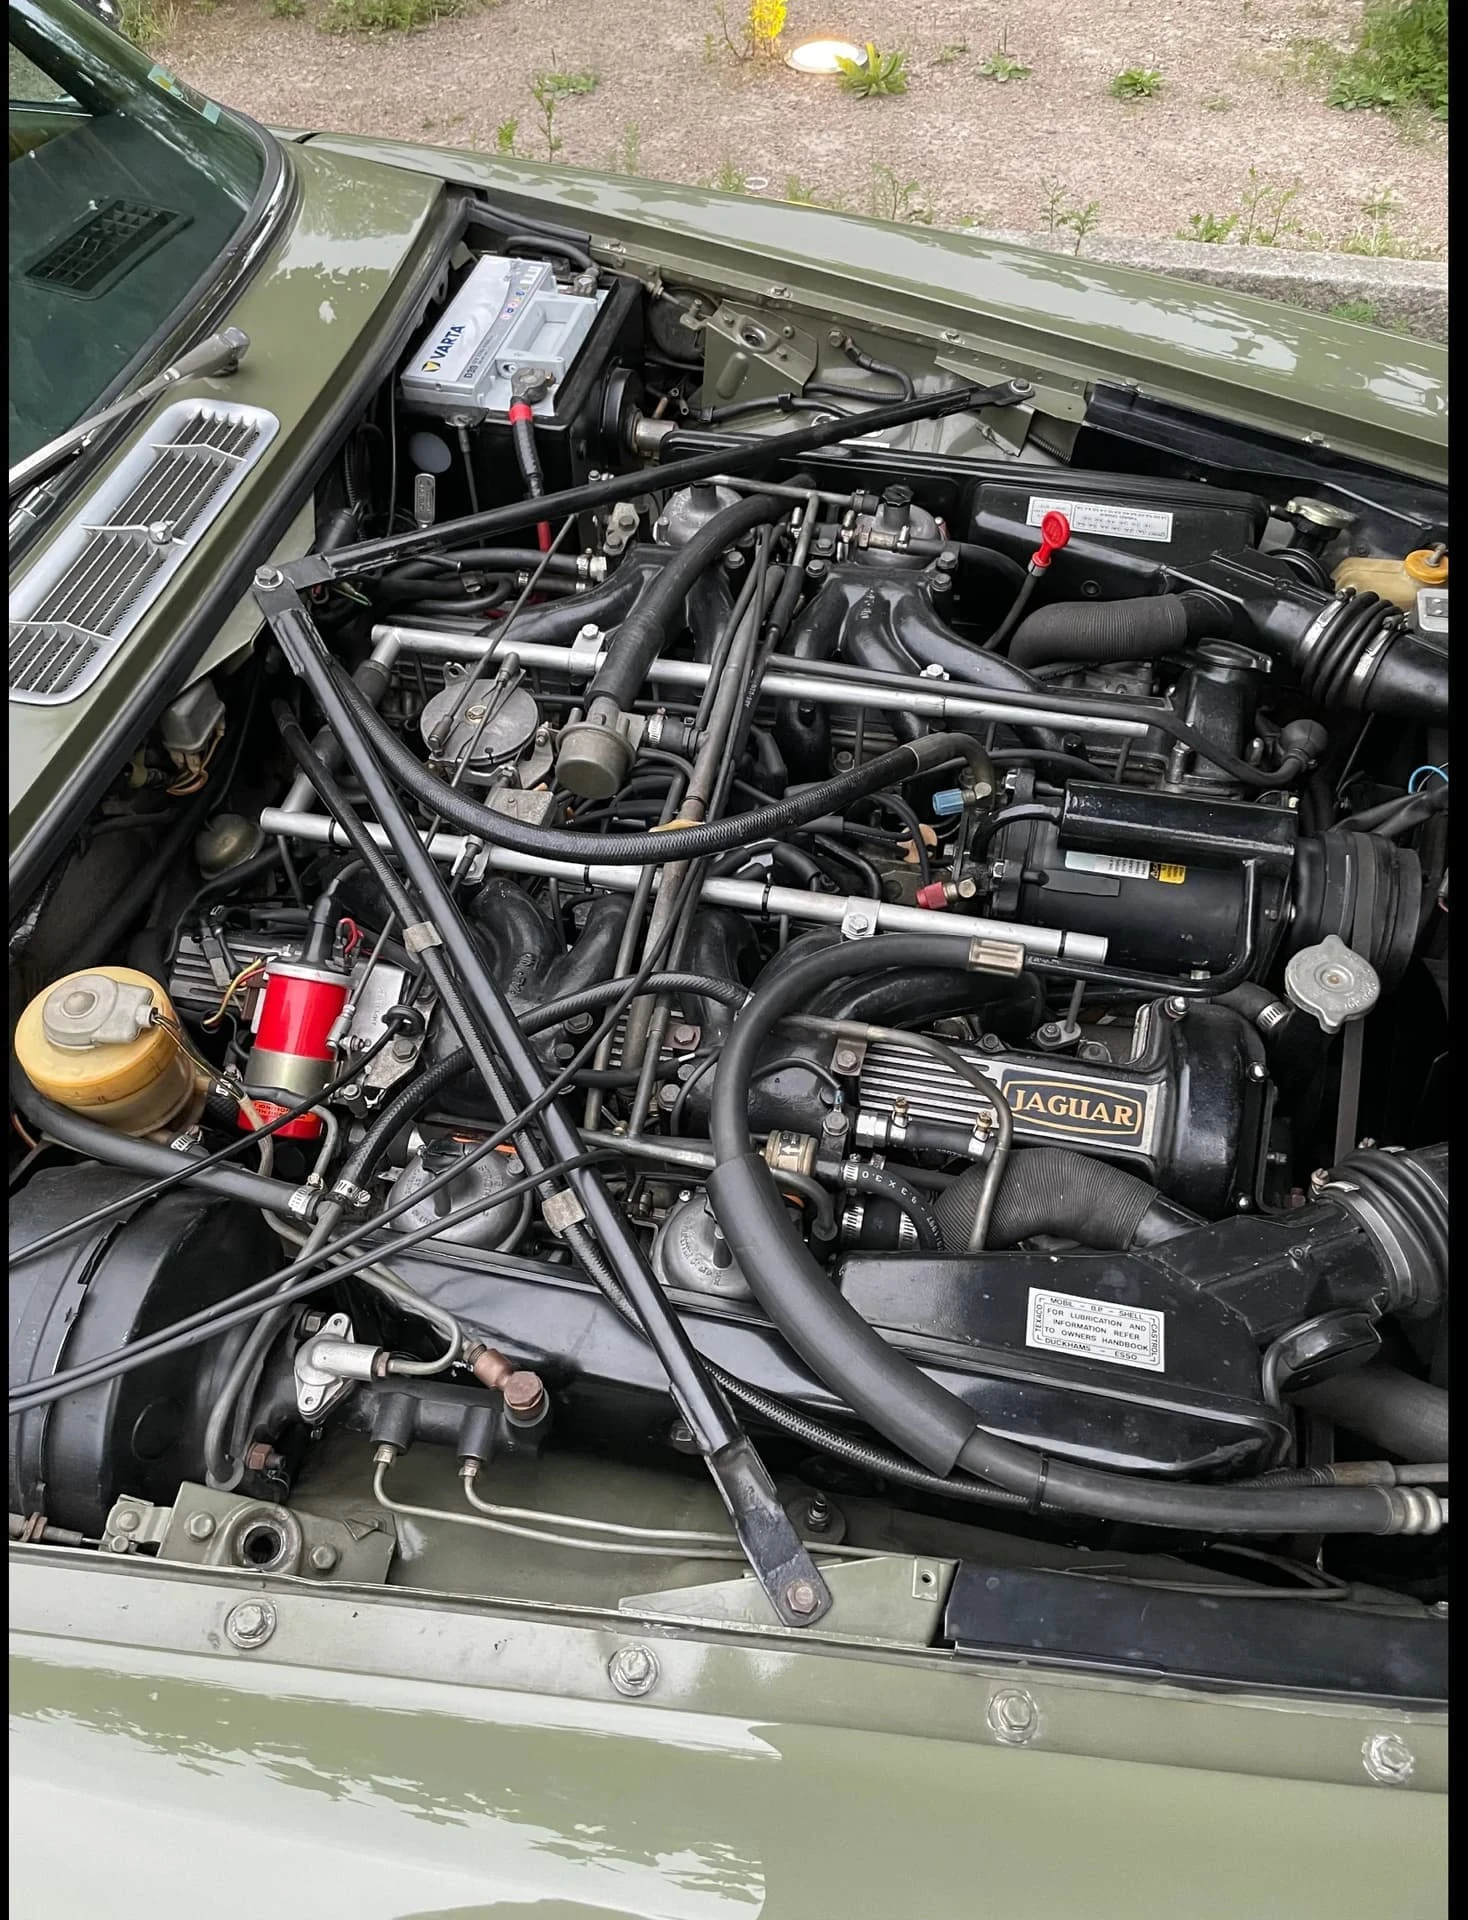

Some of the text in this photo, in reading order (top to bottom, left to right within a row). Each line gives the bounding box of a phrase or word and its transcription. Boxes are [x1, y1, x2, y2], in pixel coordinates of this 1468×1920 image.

[430, 326, 465, 359] VARTA
[1010, 1089, 1135, 1126] JAGUAR
[1035, 1304, 1043, 1332] TEXACO
[1047, 1308, 1147, 1332] FOR LUBRICATION AND
[1050, 1297, 1073, 1308] MOBIL
[1119, 1310, 1144, 1320] SHELL
[1044, 1326, 1149, 1351] TO OWNERS HANDBOOK
[1053, 1319, 1140, 1340] INFORMATION REFER
[1045, 1338, 1138, 1360] DUCKHAMS ESSO
